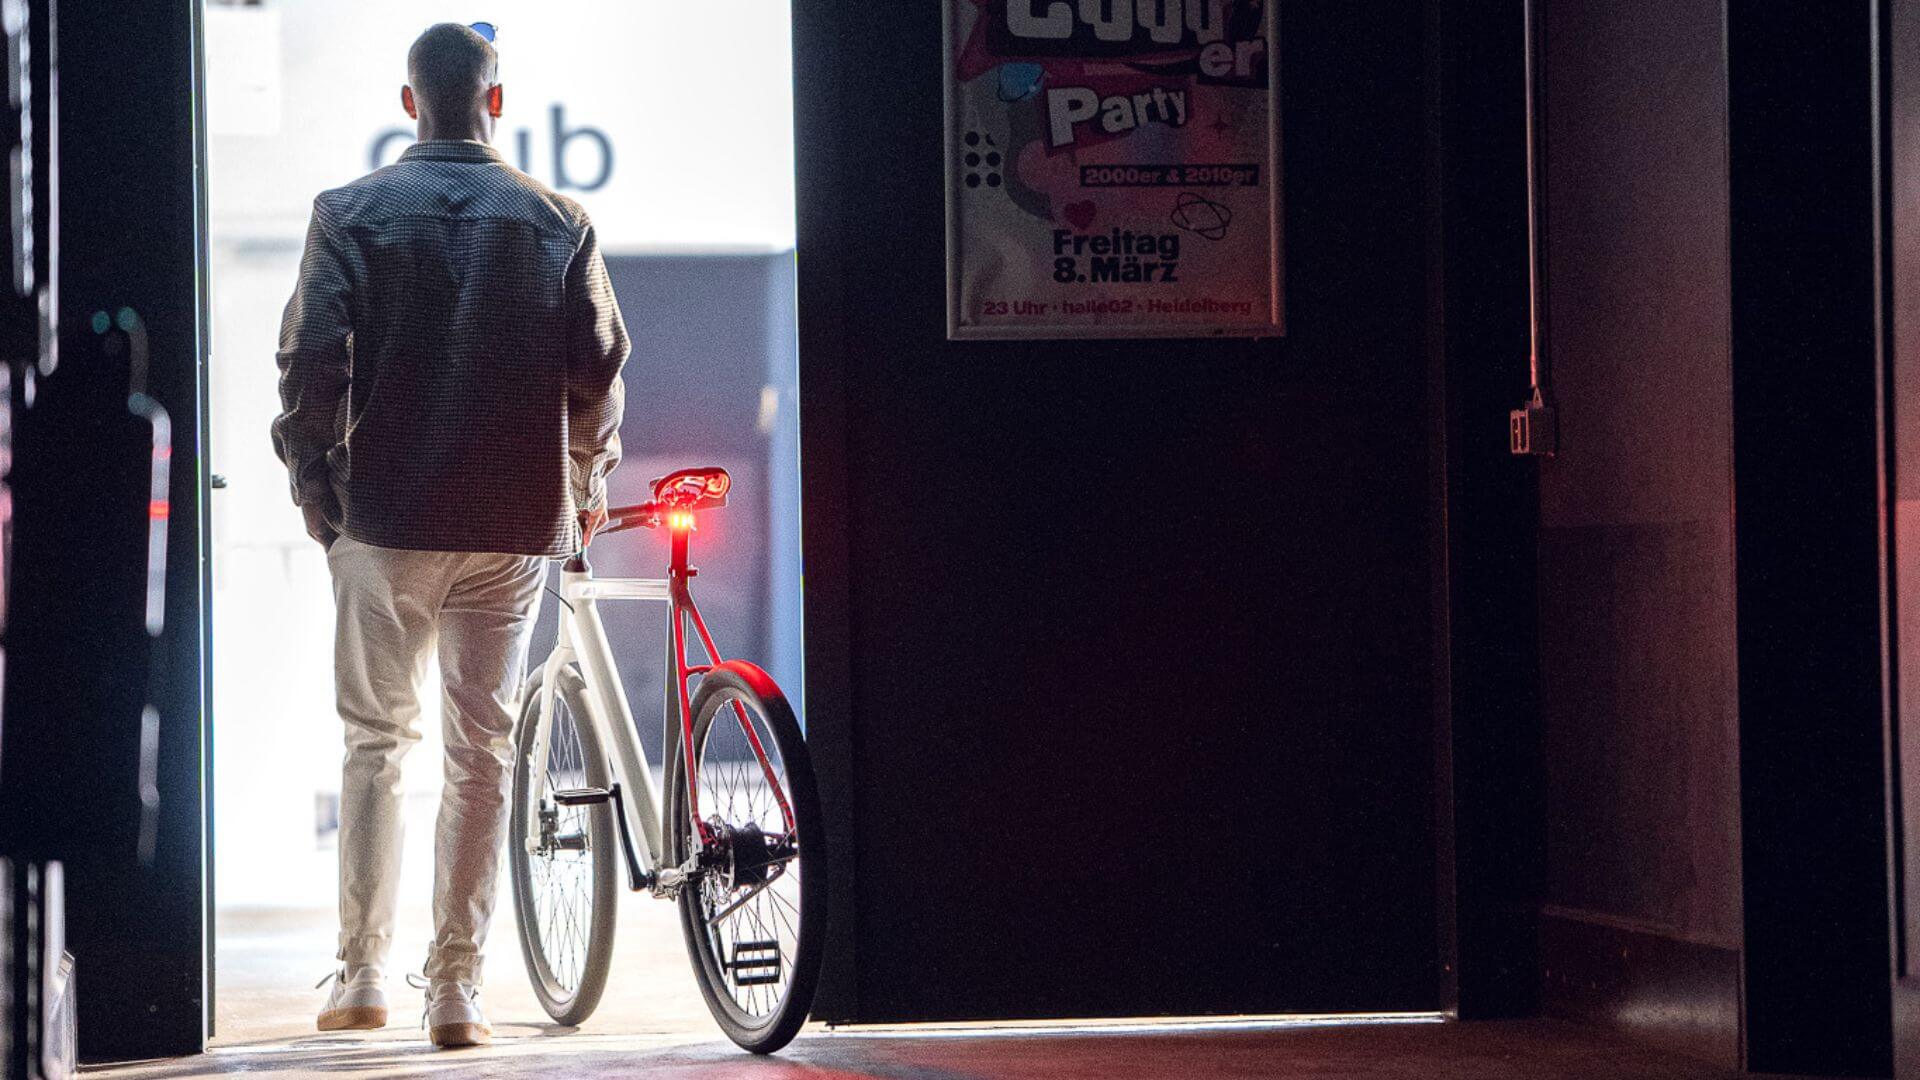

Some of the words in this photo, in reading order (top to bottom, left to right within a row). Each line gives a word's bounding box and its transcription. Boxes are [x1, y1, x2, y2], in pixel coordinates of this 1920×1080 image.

[1200, 38, 1263, 77] er
[1048, 86, 1186, 147] Party
[1085, 168, 1161, 185] 2000er
[1053, 227, 1179, 260] Freitag
[1091, 257, 1178, 283] März
[984, 301, 1008, 315] 23
[1014, 301, 1047, 315] Uhr
[1147, 299, 1251, 315] Heidelberg
